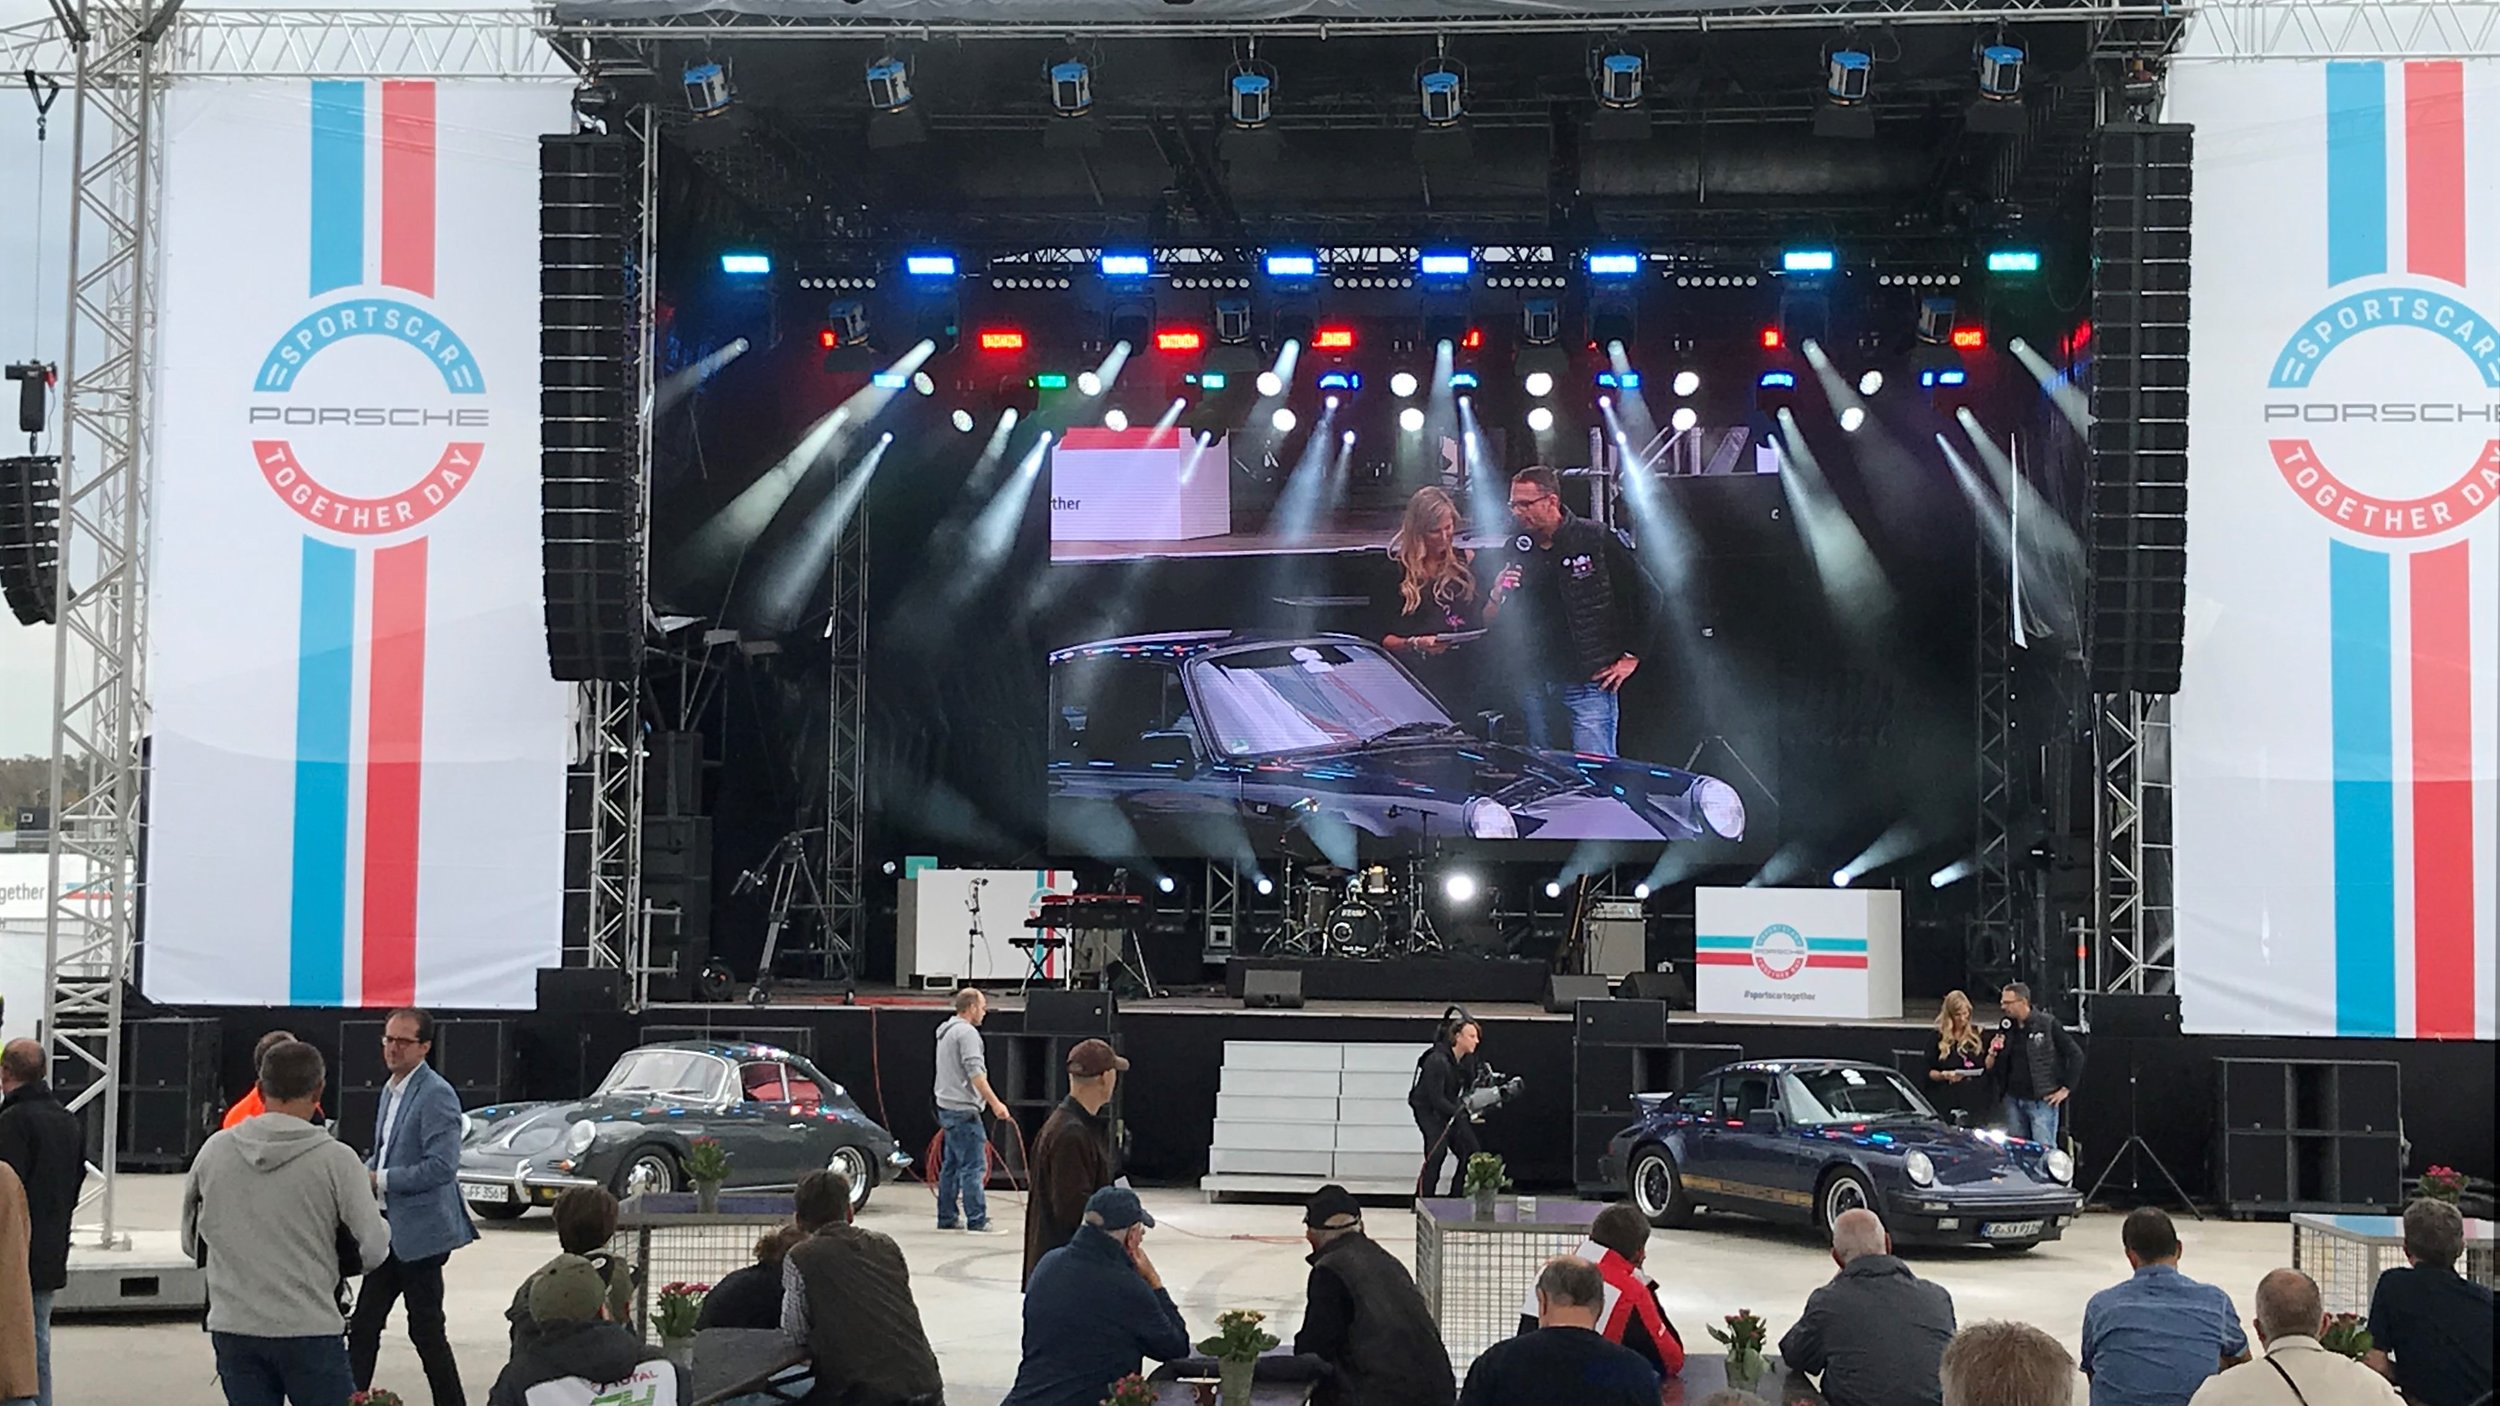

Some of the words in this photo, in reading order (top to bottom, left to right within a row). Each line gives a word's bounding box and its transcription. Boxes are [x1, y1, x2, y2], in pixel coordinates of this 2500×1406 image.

[280, 306, 460, 366] SPORTSCAR
[2297, 296, 2496, 359] SPORTSCAR
[249, 406, 490, 427] PORSCHE
[2264, 403, 2499, 423] PORSCH
[264, 447, 414, 529] TOGETHER
[423, 449, 472, 506] DAY
[2283, 446, 2453, 531] TOGETHER
